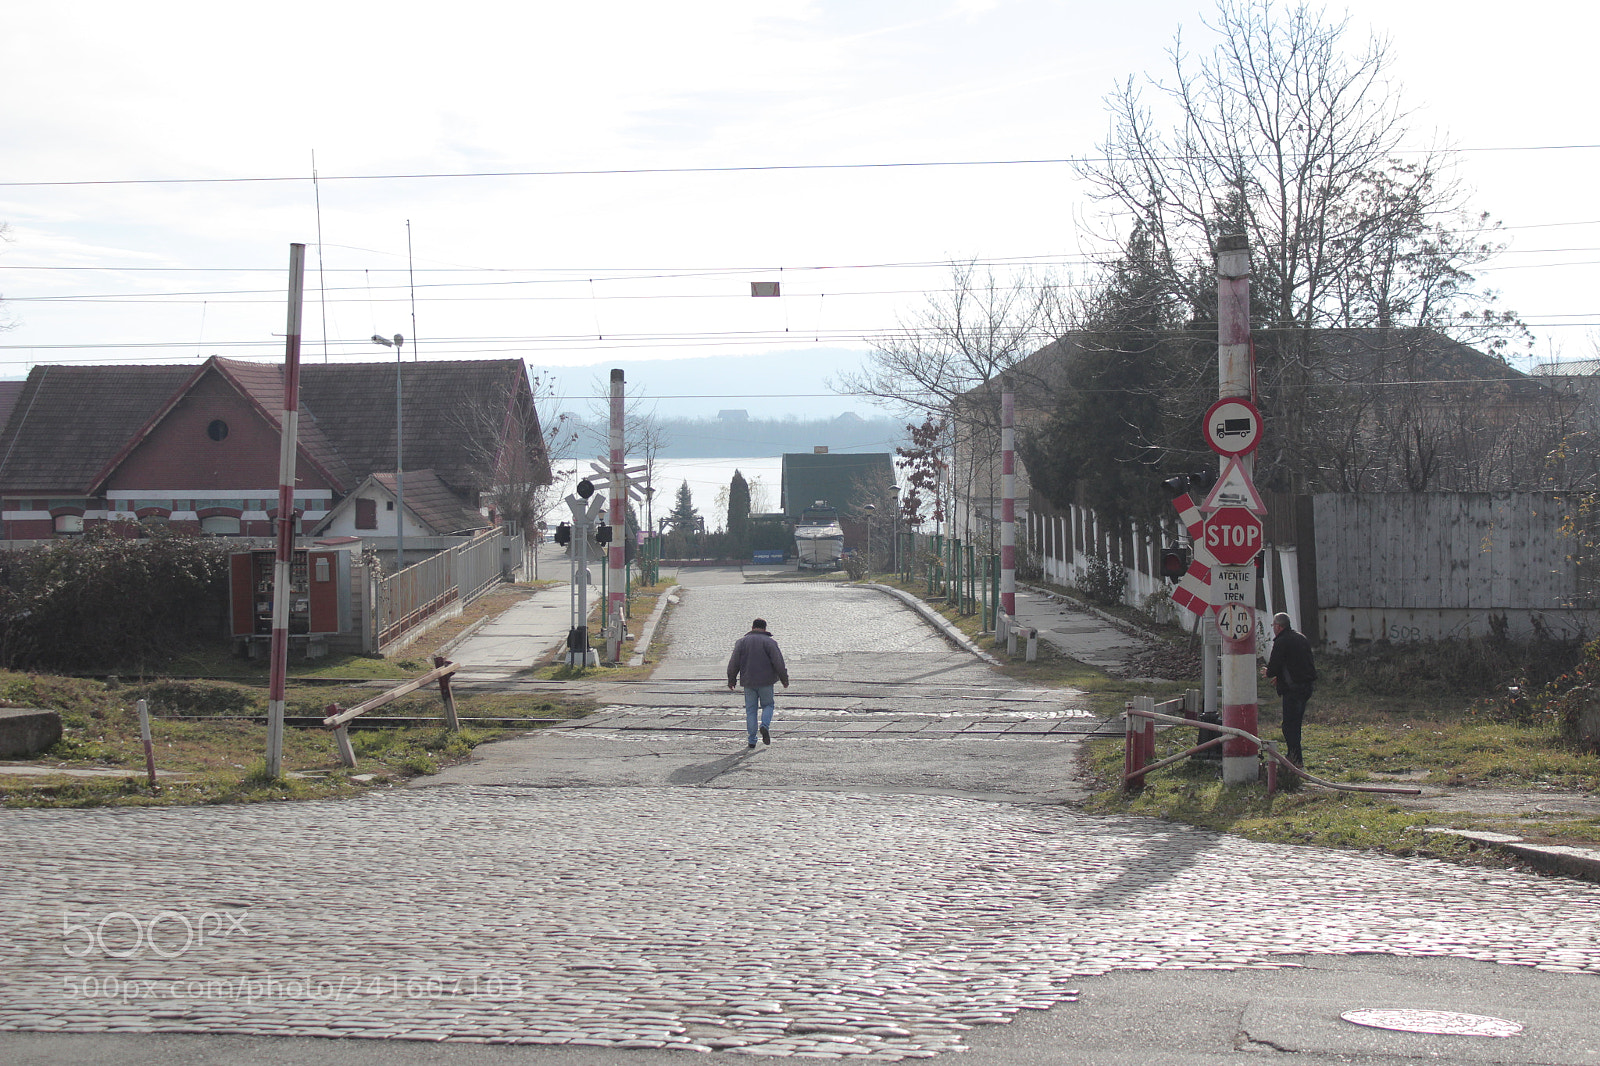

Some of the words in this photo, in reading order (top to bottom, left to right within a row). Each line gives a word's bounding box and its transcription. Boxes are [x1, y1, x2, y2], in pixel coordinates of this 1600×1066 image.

[1207, 525, 1259, 547] STOP
[1219, 572, 1250, 582] ATENTIE
[1228, 583, 1239, 591] LA
[1224, 593, 1245, 601] TREN
[1220, 612, 1230, 631] 4
[1238, 612, 1248, 621] m
[1235, 624, 1249, 634] 00
